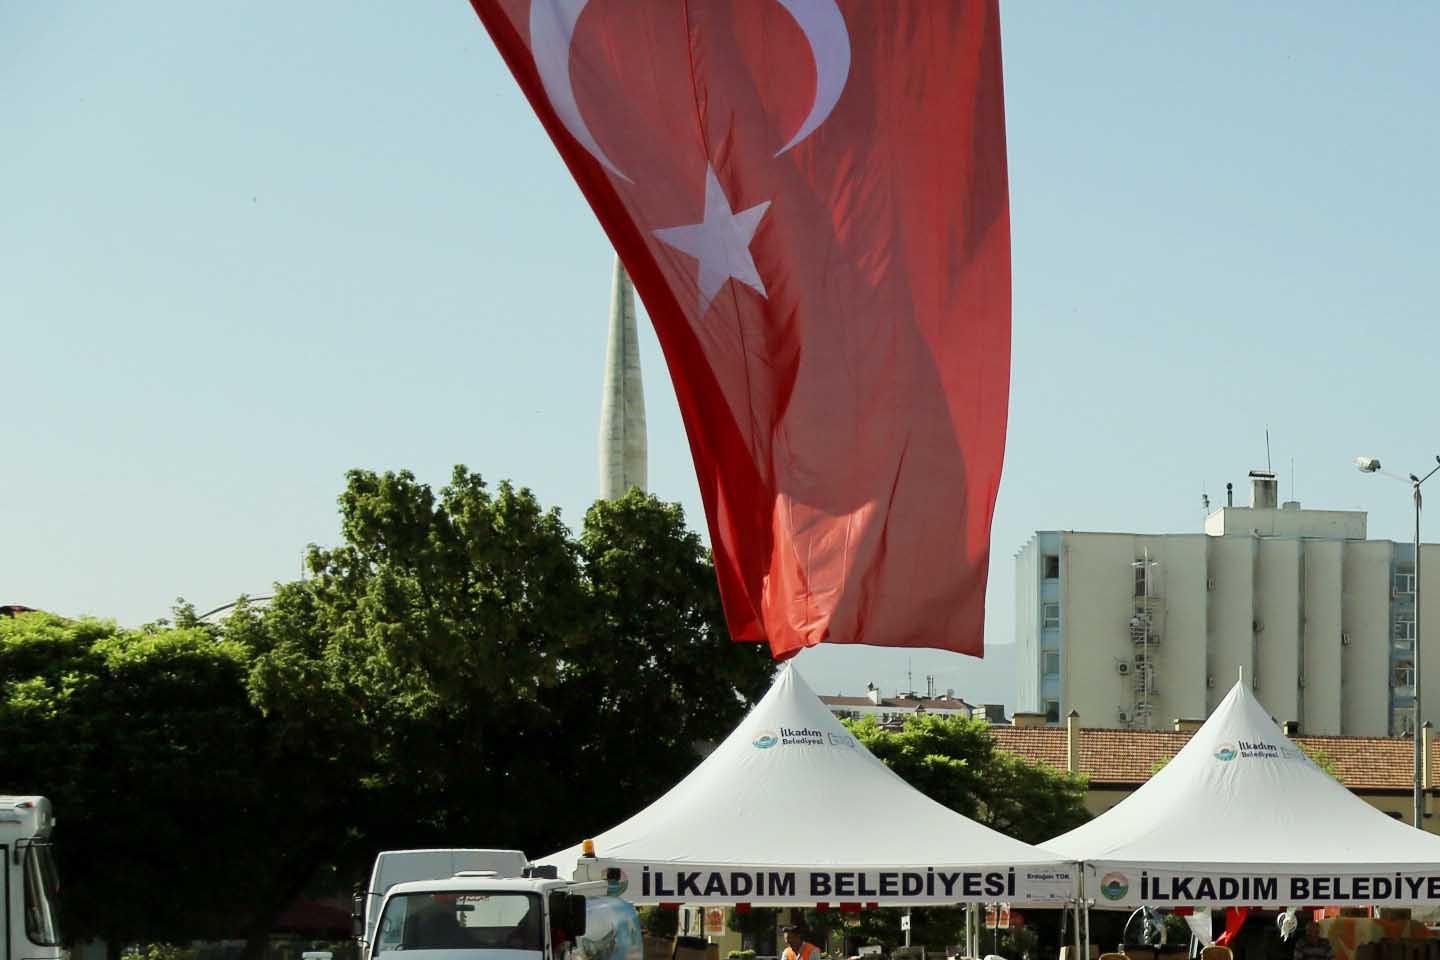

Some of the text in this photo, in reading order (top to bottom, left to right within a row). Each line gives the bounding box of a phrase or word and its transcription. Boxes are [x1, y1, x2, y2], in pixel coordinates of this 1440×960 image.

[780, 728, 822, 737] İlkadım
[642, 866, 1016, 897] İLKADIM BELEDİYESİ
[1141, 871, 1278, 900] İLKADIM
